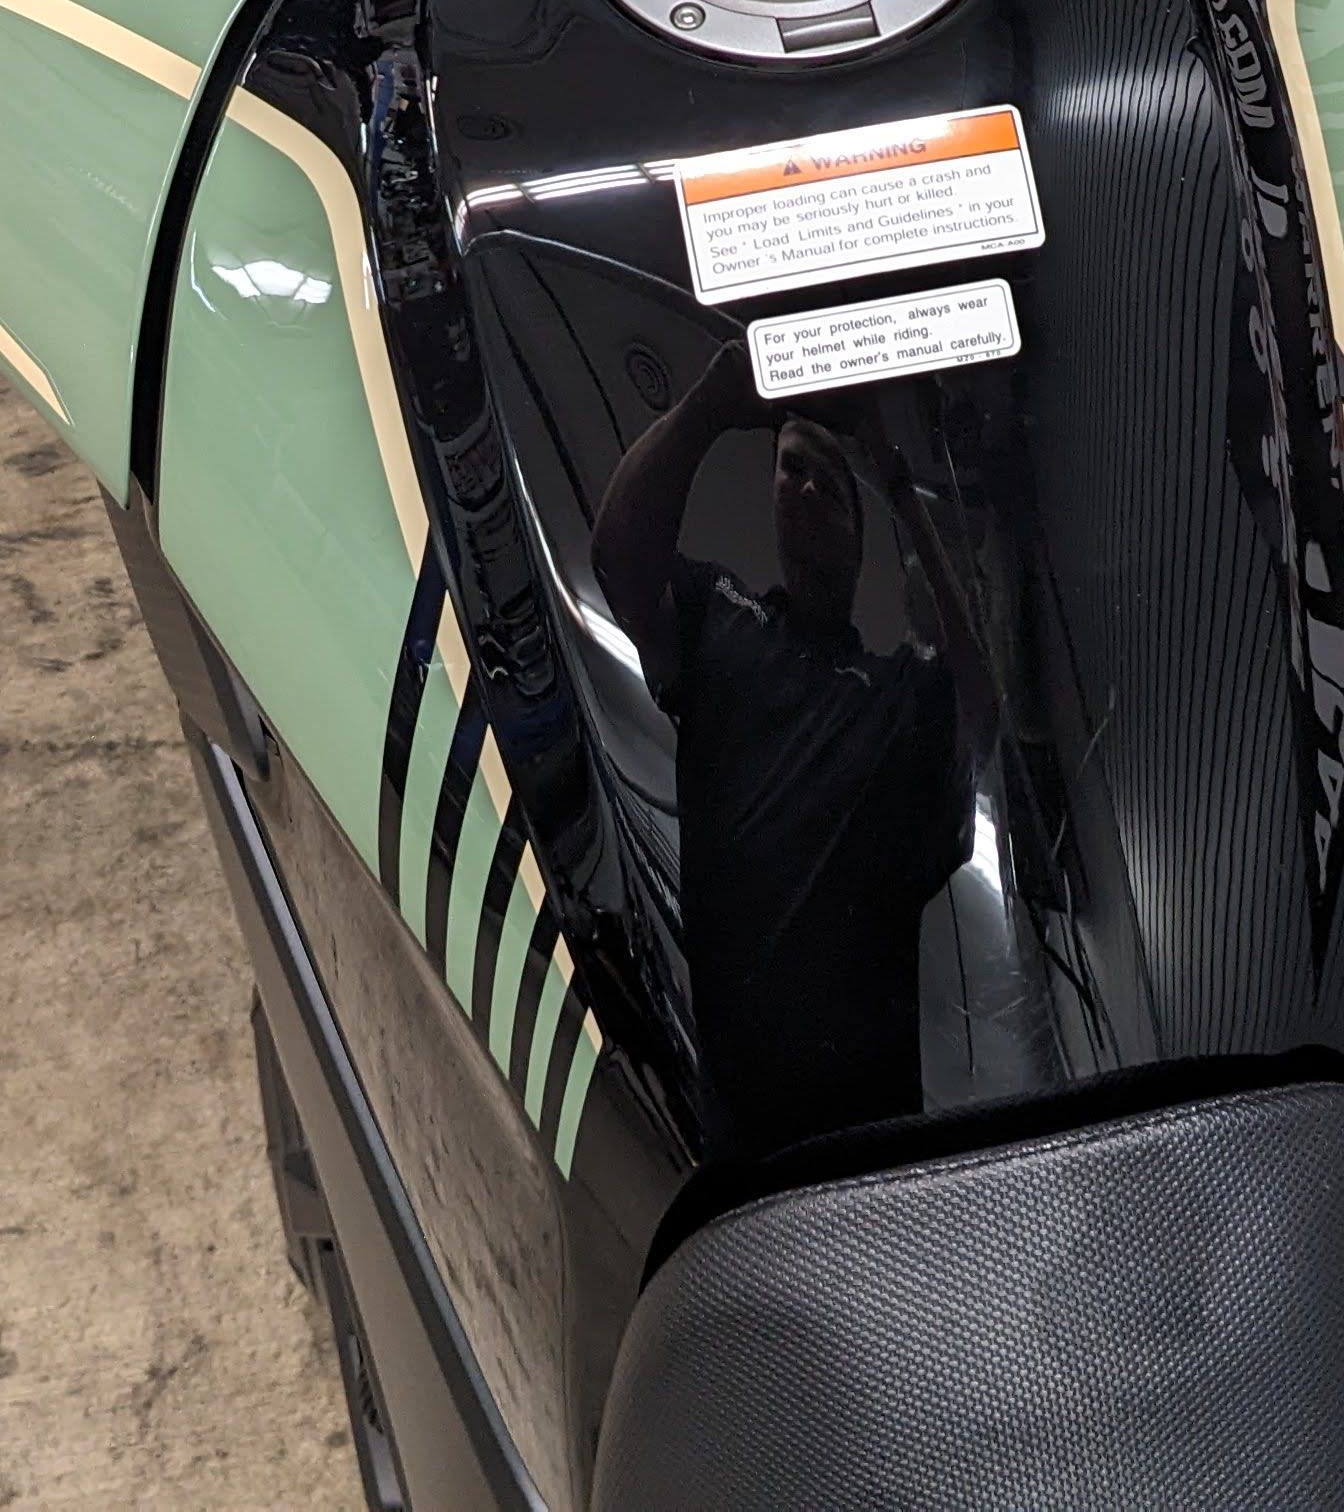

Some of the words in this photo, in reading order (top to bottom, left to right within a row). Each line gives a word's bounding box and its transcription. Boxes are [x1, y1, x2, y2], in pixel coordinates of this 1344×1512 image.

[809, 137, 927, 172] WARNING
[702, 203, 767, 224] Improper
[772, 192, 826, 210] loading
[829, 187, 858, 201] can
[861, 179, 904, 195] cause
[921, 169, 961, 185] crash
[965, 163, 992, 178] and
[706, 226, 733, 243] you
[737, 219, 768, 233] may
[772, 215, 791, 227] be
[795, 201, 860, 223] seriously
[864, 196, 893, 210] hurt
[897, 194, 911, 205] or
[709, 245, 738, 259] See
[752, 232, 790, 250] Load
[798, 225, 842, 242] Limits
[847, 218, 874, 233] and
[877, 207, 954, 228] Guidelines
[968, 201, 981, 213] in
[984, 197, 1014, 214] your
[781, 241, 836, 262] Manual
[838, 239, 859, 251] for
[863, 227, 929, 247] complete
[763, 332, 786, 346] For
[792, 326, 822, 344] your
[828, 314, 897, 337] protection,
[907, 304, 952, 321] always
[957, 297, 988, 312] wear
[765, 350, 795, 367] your
[801, 339, 847, 358] helmet
[852, 333, 886, 349] while
[892, 326, 933, 342] riding.
[769, 364, 805, 383] Read
[810, 362, 832, 375] the
[839, 350, 890, 370] owner's
[896, 339, 944, 360] manual
[949, 330, 1007, 351] carefully.
